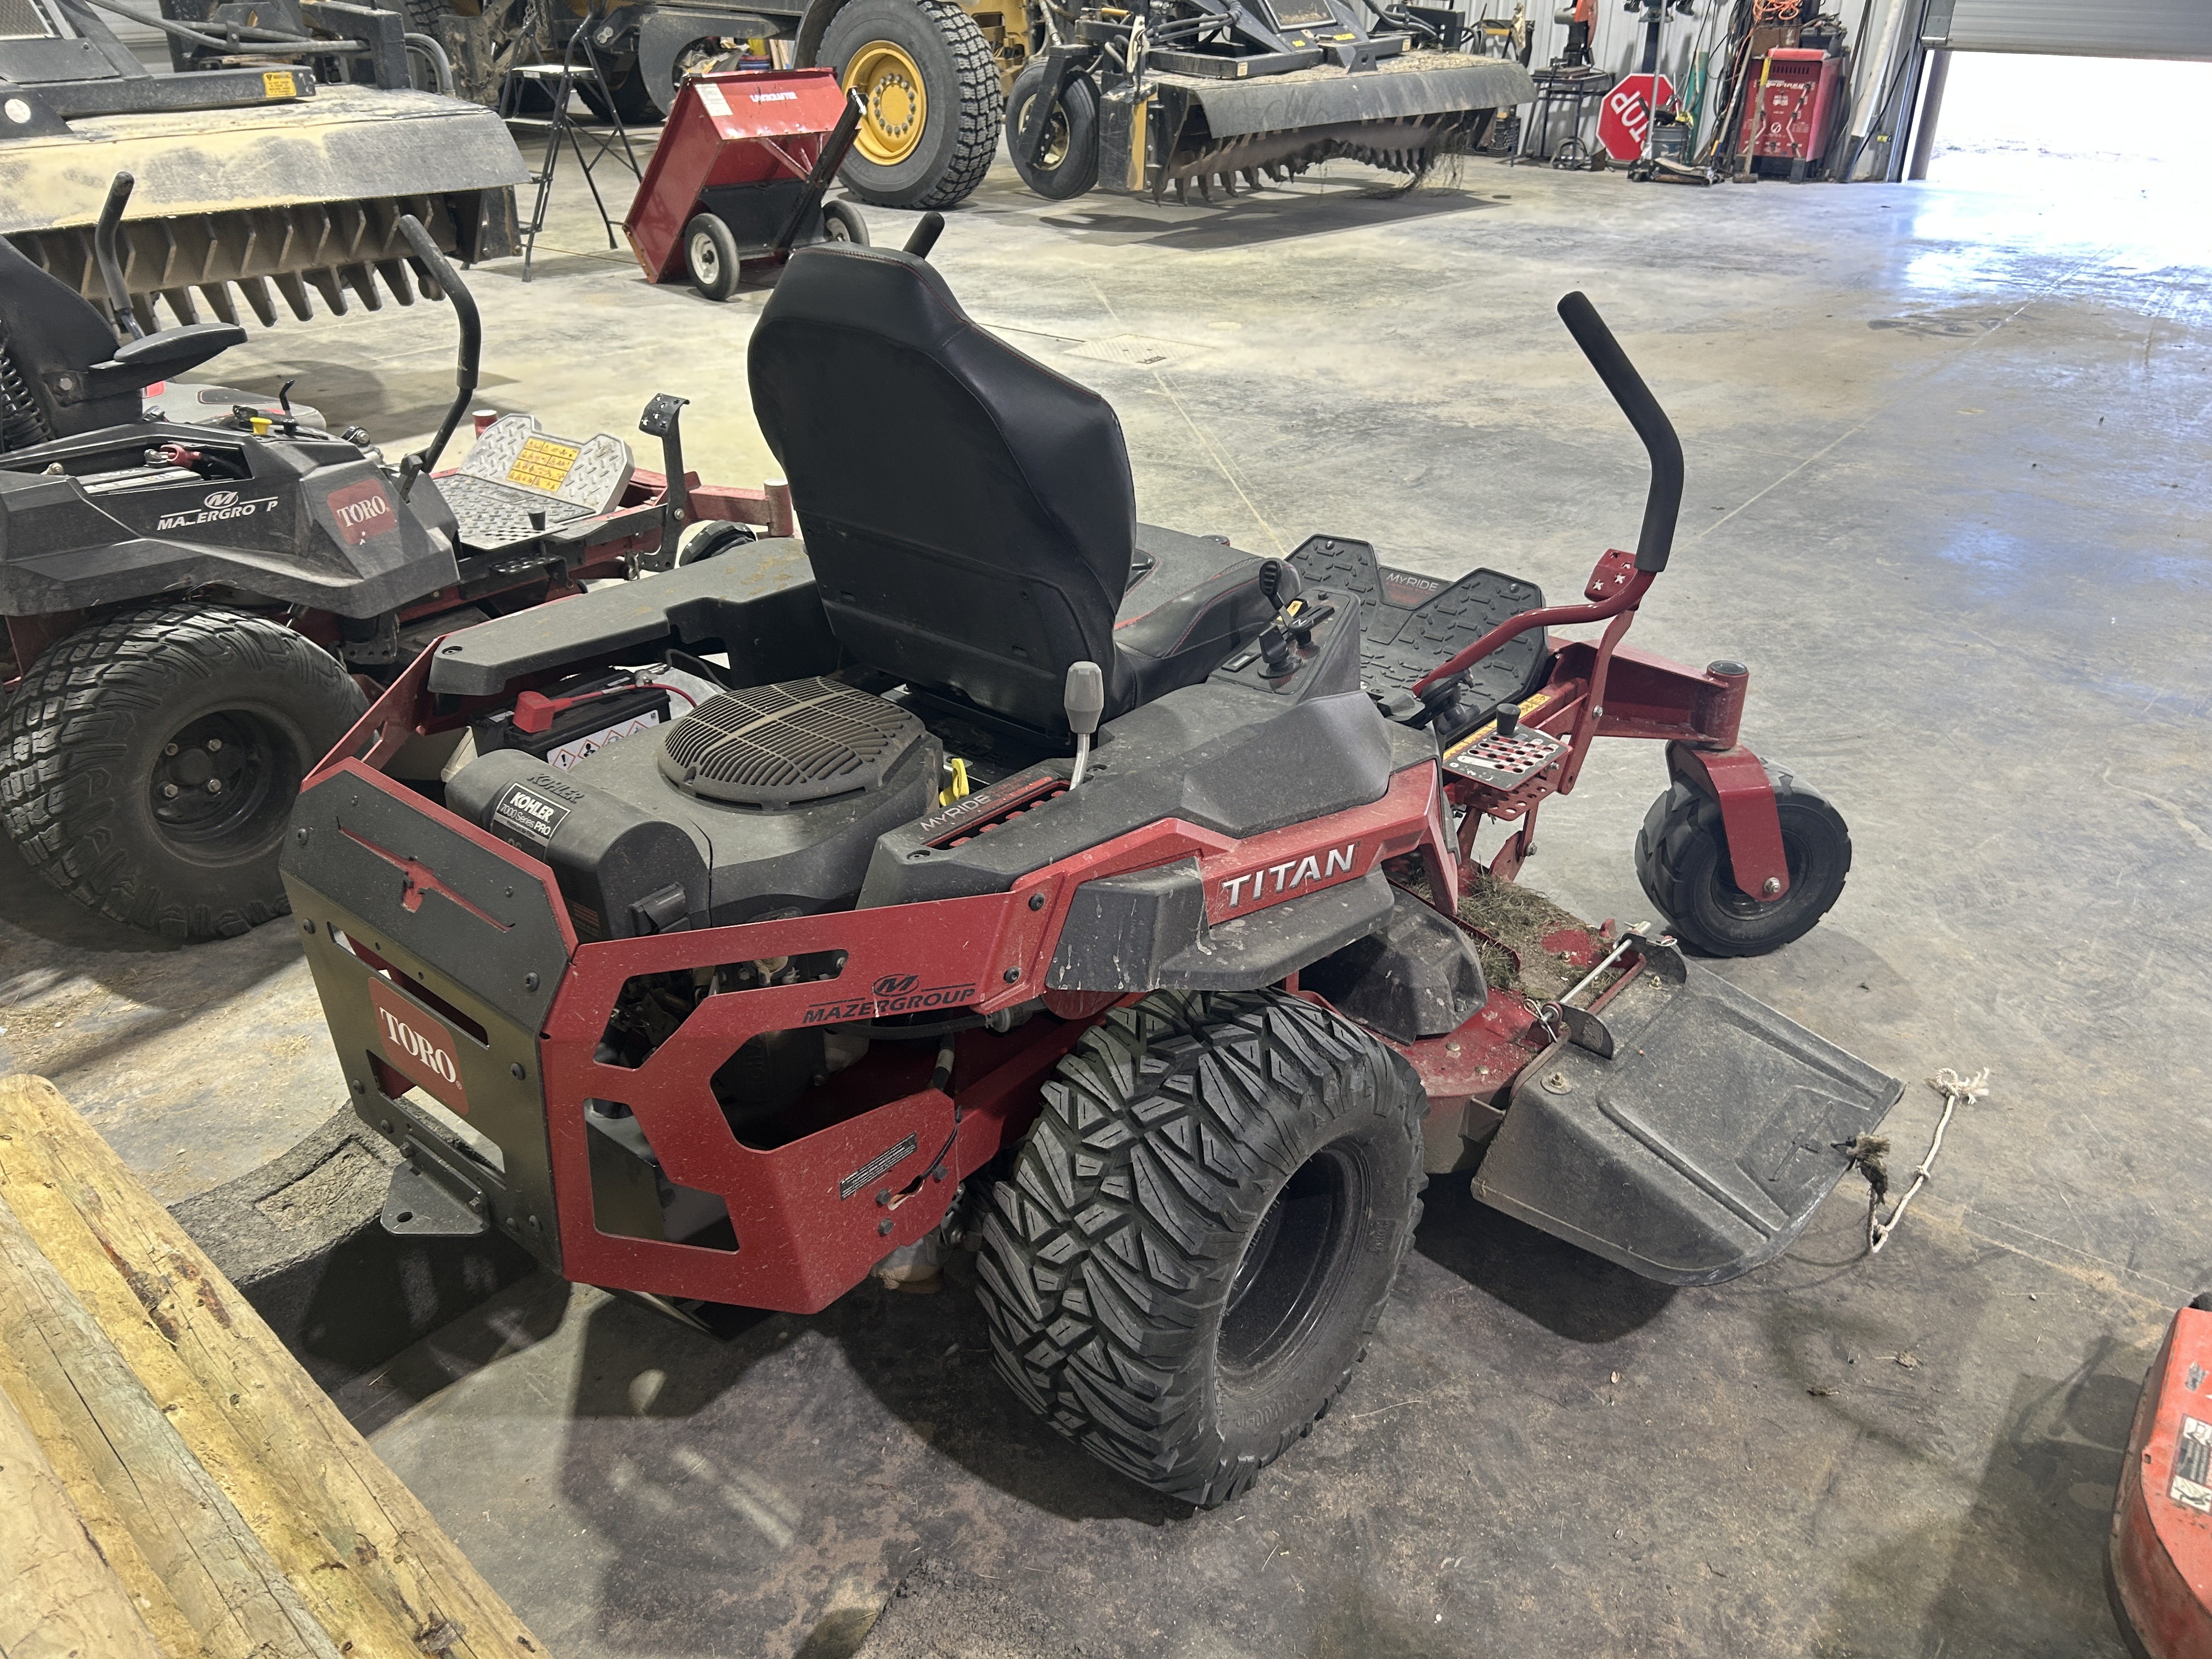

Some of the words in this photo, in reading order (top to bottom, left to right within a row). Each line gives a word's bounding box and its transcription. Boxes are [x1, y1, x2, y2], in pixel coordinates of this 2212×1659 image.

[1611, 91, 1649, 151] TOP
[156, 500, 278, 531] MAERGROP
[336, 495, 386, 527] TORO
[526, 773, 585, 804] KOHLER
[500, 803, 517, 818] 7000
[515, 812, 535, 828] Series
[534, 821, 551, 836] PRO
[1221, 843, 1355, 909] TITAN
[802, 988, 975, 1024] MAZERGROUP
[379, 1006, 456, 1083] TORO
